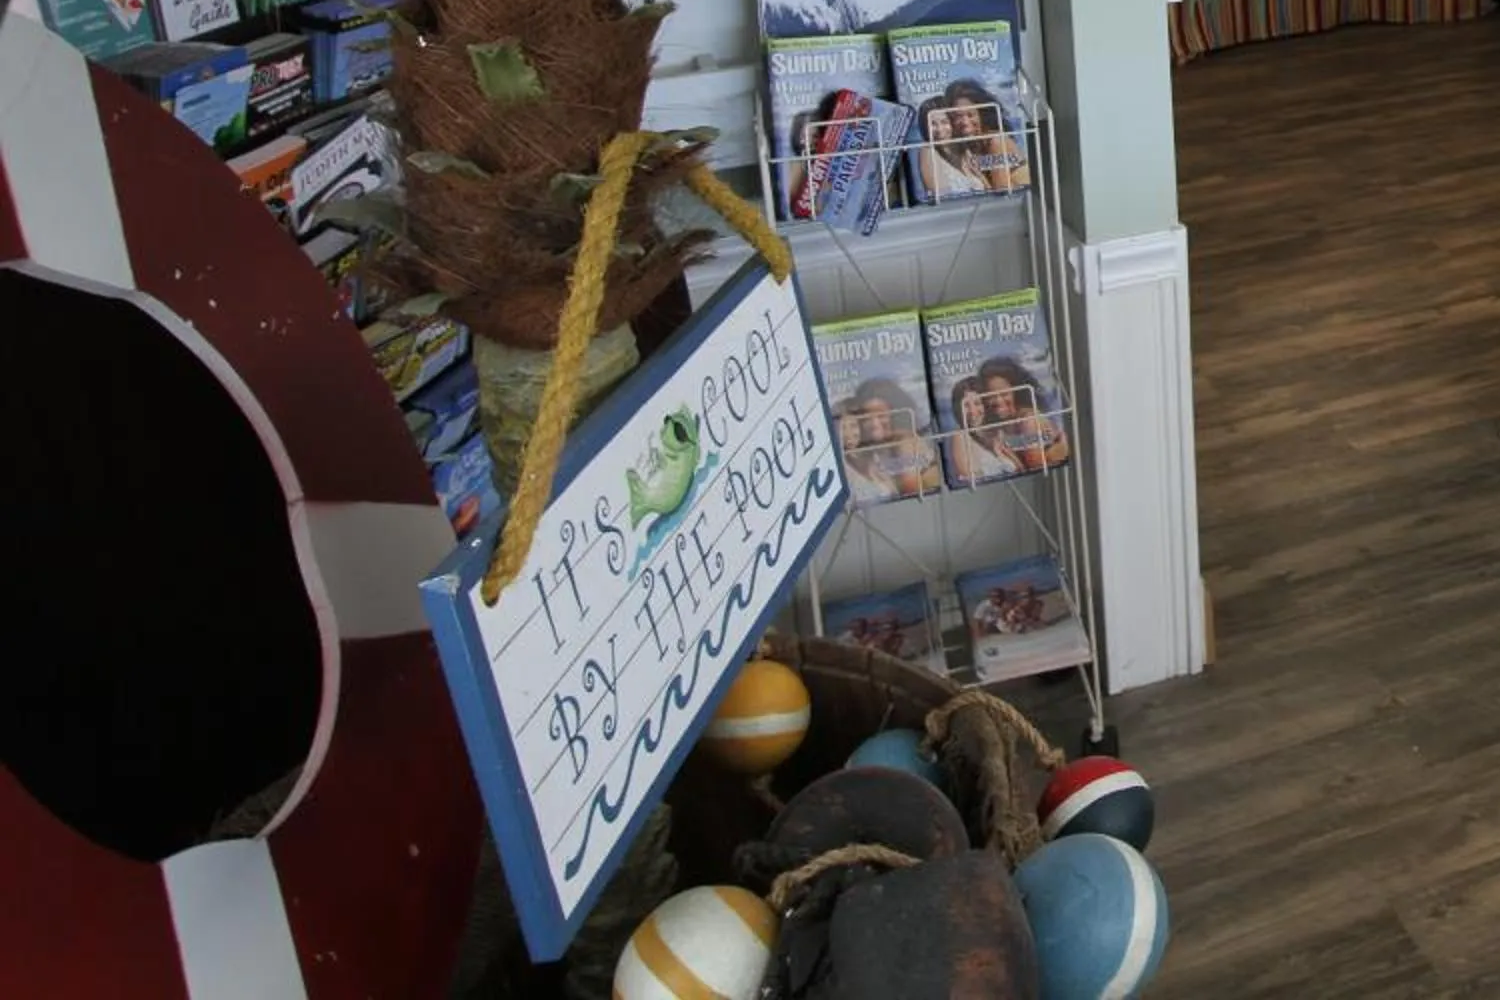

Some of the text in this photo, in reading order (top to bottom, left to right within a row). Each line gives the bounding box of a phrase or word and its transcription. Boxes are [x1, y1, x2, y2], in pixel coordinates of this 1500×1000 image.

[189, 4, 233, 32] Guide
[771, 48, 882, 76] Sunny Day
[894, 42, 958, 66] Sunny
[961, 37, 999, 62] Day
[876, 331, 915, 354] Day
[928, 318, 993, 347] Sunny
[997, 312, 1036, 335] Day
[532, 308, 793, 655] IT'S COOL
[548, 398, 817, 786] BY THE POOL
